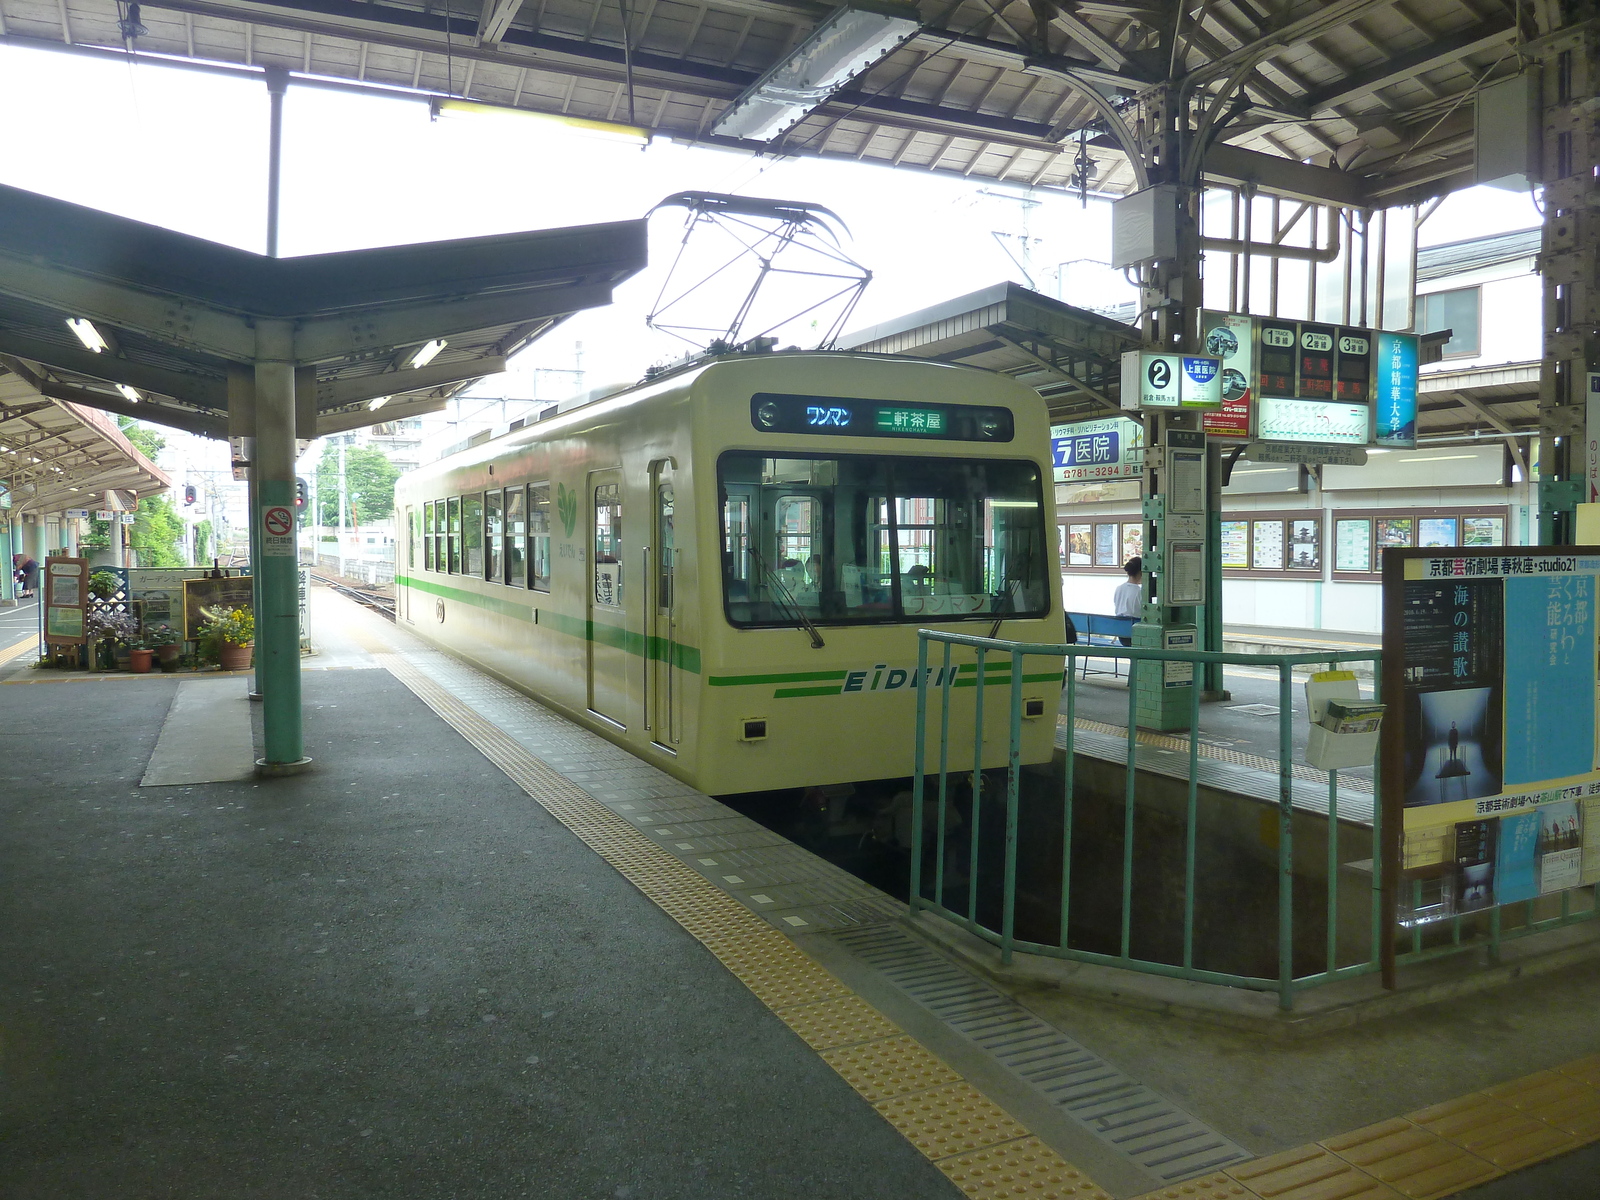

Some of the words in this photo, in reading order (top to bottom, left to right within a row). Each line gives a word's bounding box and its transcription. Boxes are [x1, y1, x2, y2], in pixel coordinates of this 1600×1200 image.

[1268, 330, 1273, 343] 1
[1275, 337, 1288, 345] 番線
[1306, 334, 1314, 348] 2
[1314, 341, 1327, 349] 番線
[1344, 338, 1351, 351] 3
[1153, 362, 1166, 386] 2
[1390, 339, 1402, 431] 京都精華大学
[806, 406, 852, 427] ワンマン
[877, 411, 941, 429] 二軒茶屋
[1052, 435, 1110, 464] ラ医院
[1071, 465, 1119, 478] 781-3294
[266, 537, 293, 545] 終日禁煙
[1429, 558, 1499, 577] 京都芸術劇場
[911, 596, 985, 613] ワンマン
[1453, 584, 1469, 678] 海の讃歌
